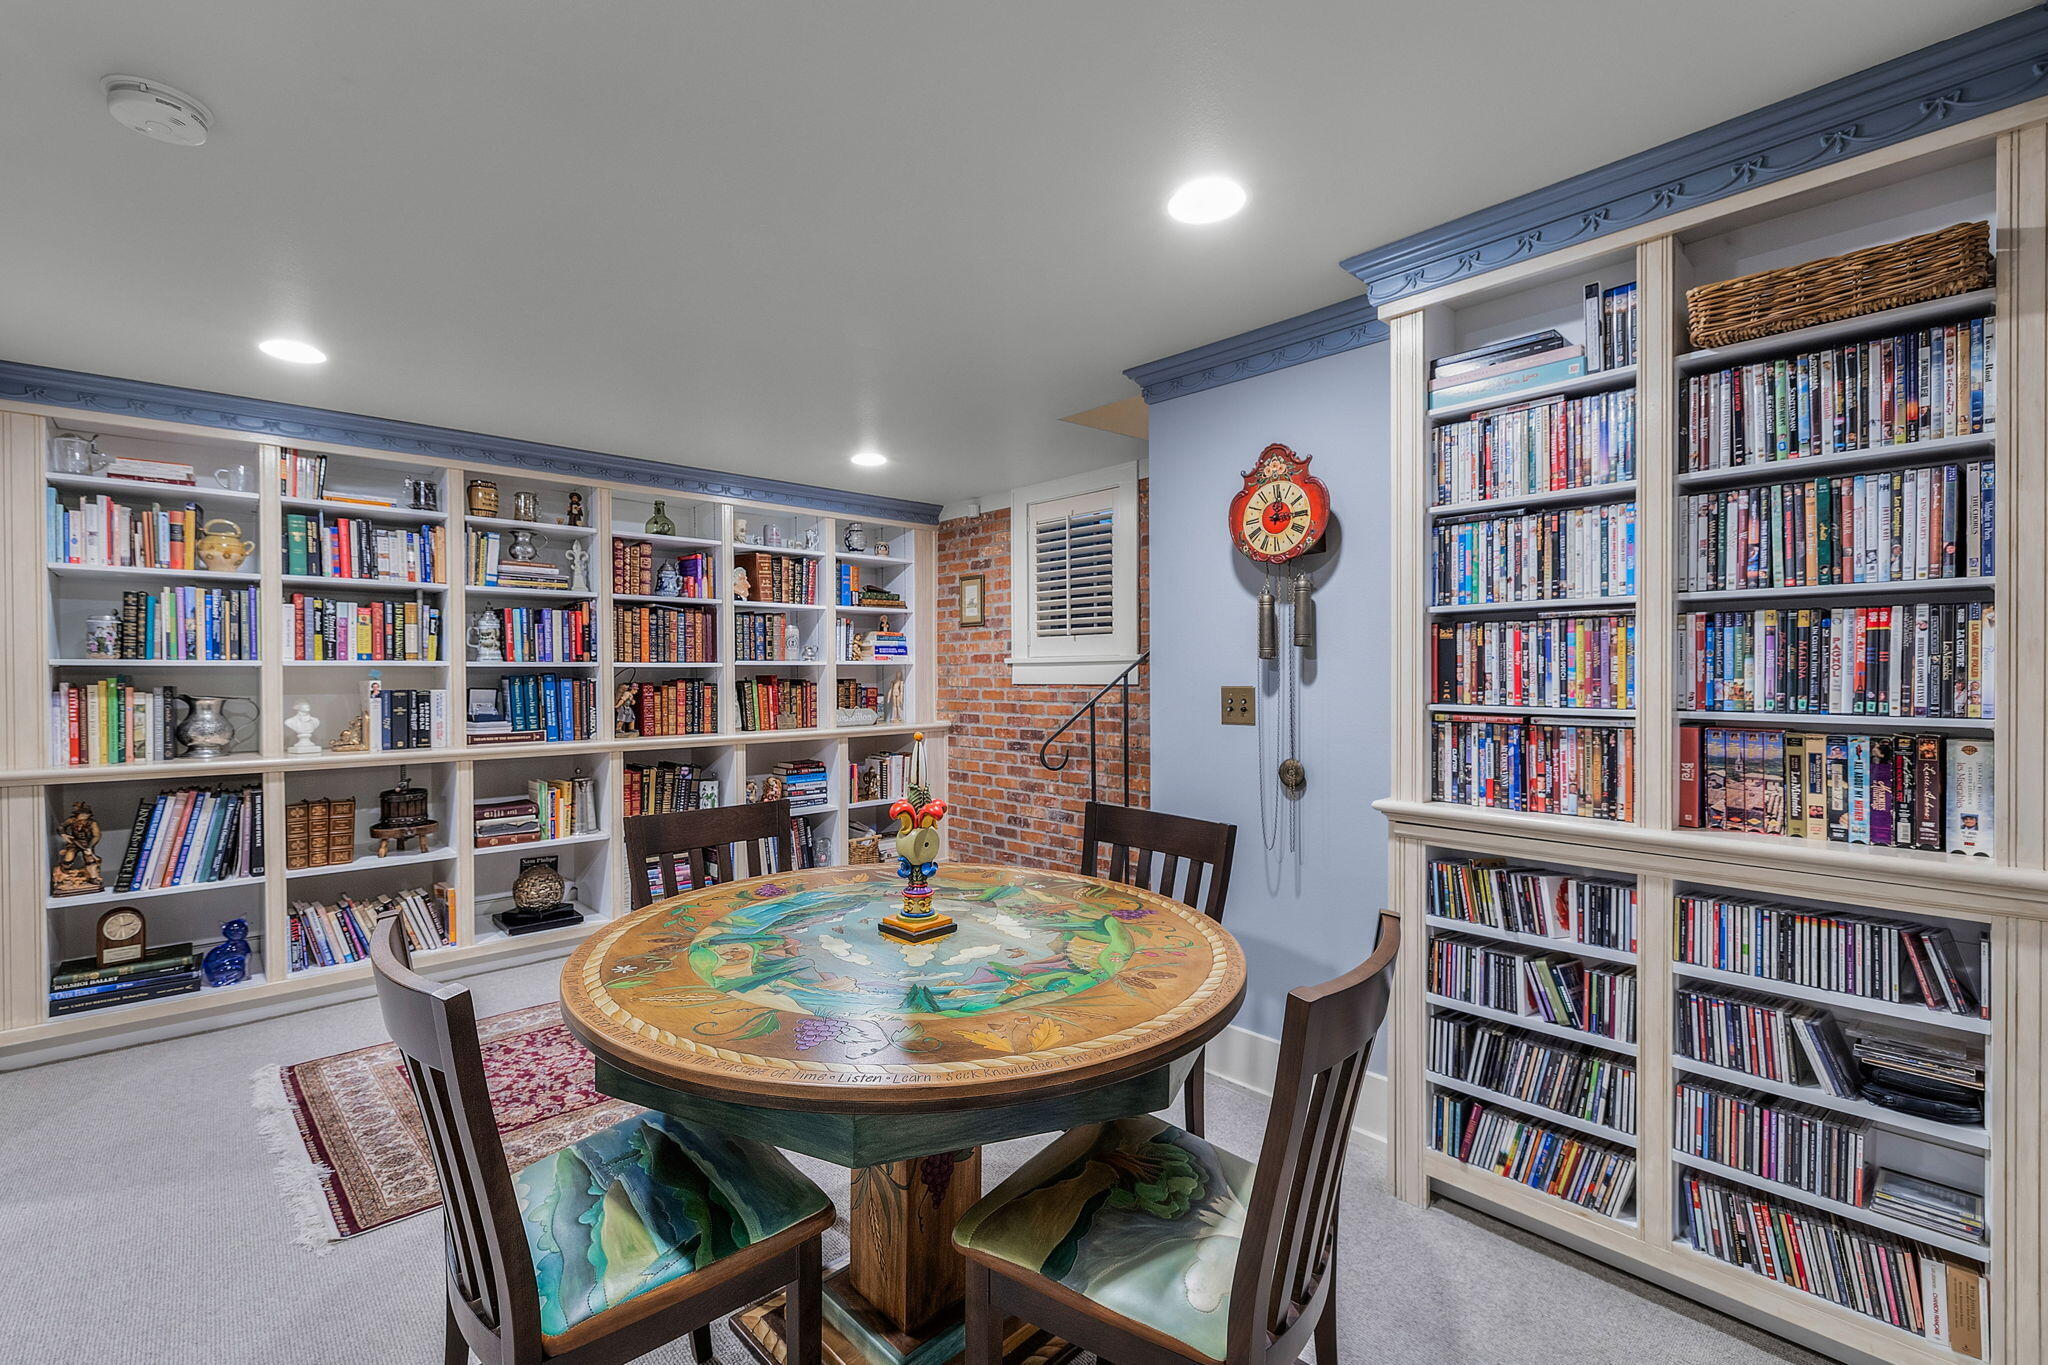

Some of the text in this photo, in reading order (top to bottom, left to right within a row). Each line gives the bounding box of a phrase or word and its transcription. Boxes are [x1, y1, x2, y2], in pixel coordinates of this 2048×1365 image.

[1853, 761, 1864, 771] ALL
[1853, 772, 1864, 790] ABOUT
[1853, 790, 1864, 799] MY
[837, 1071, 882, 1083] Listen
[892, 1073, 932, 1084] Learn
[946, 1069, 980, 1082] Seek
[984, 1059, 1054, 1078] Knowledge
